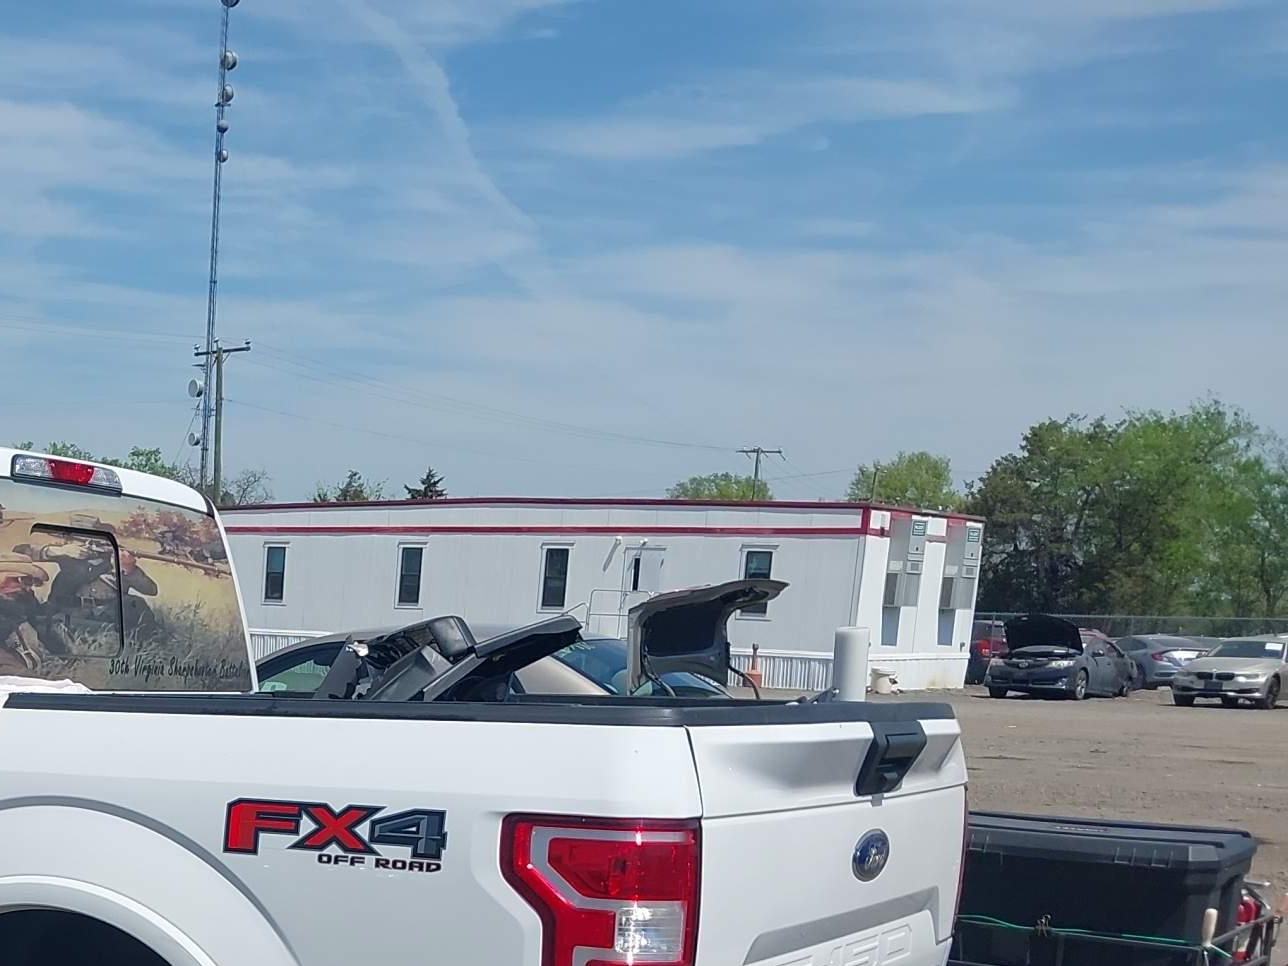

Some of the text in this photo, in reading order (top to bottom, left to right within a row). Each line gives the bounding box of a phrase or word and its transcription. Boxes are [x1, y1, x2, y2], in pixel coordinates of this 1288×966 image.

[109, 658, 130, 675] 30th
[223, 798, 448, 861] FX4
[317, 853, 442, 873] OFF ROAD
